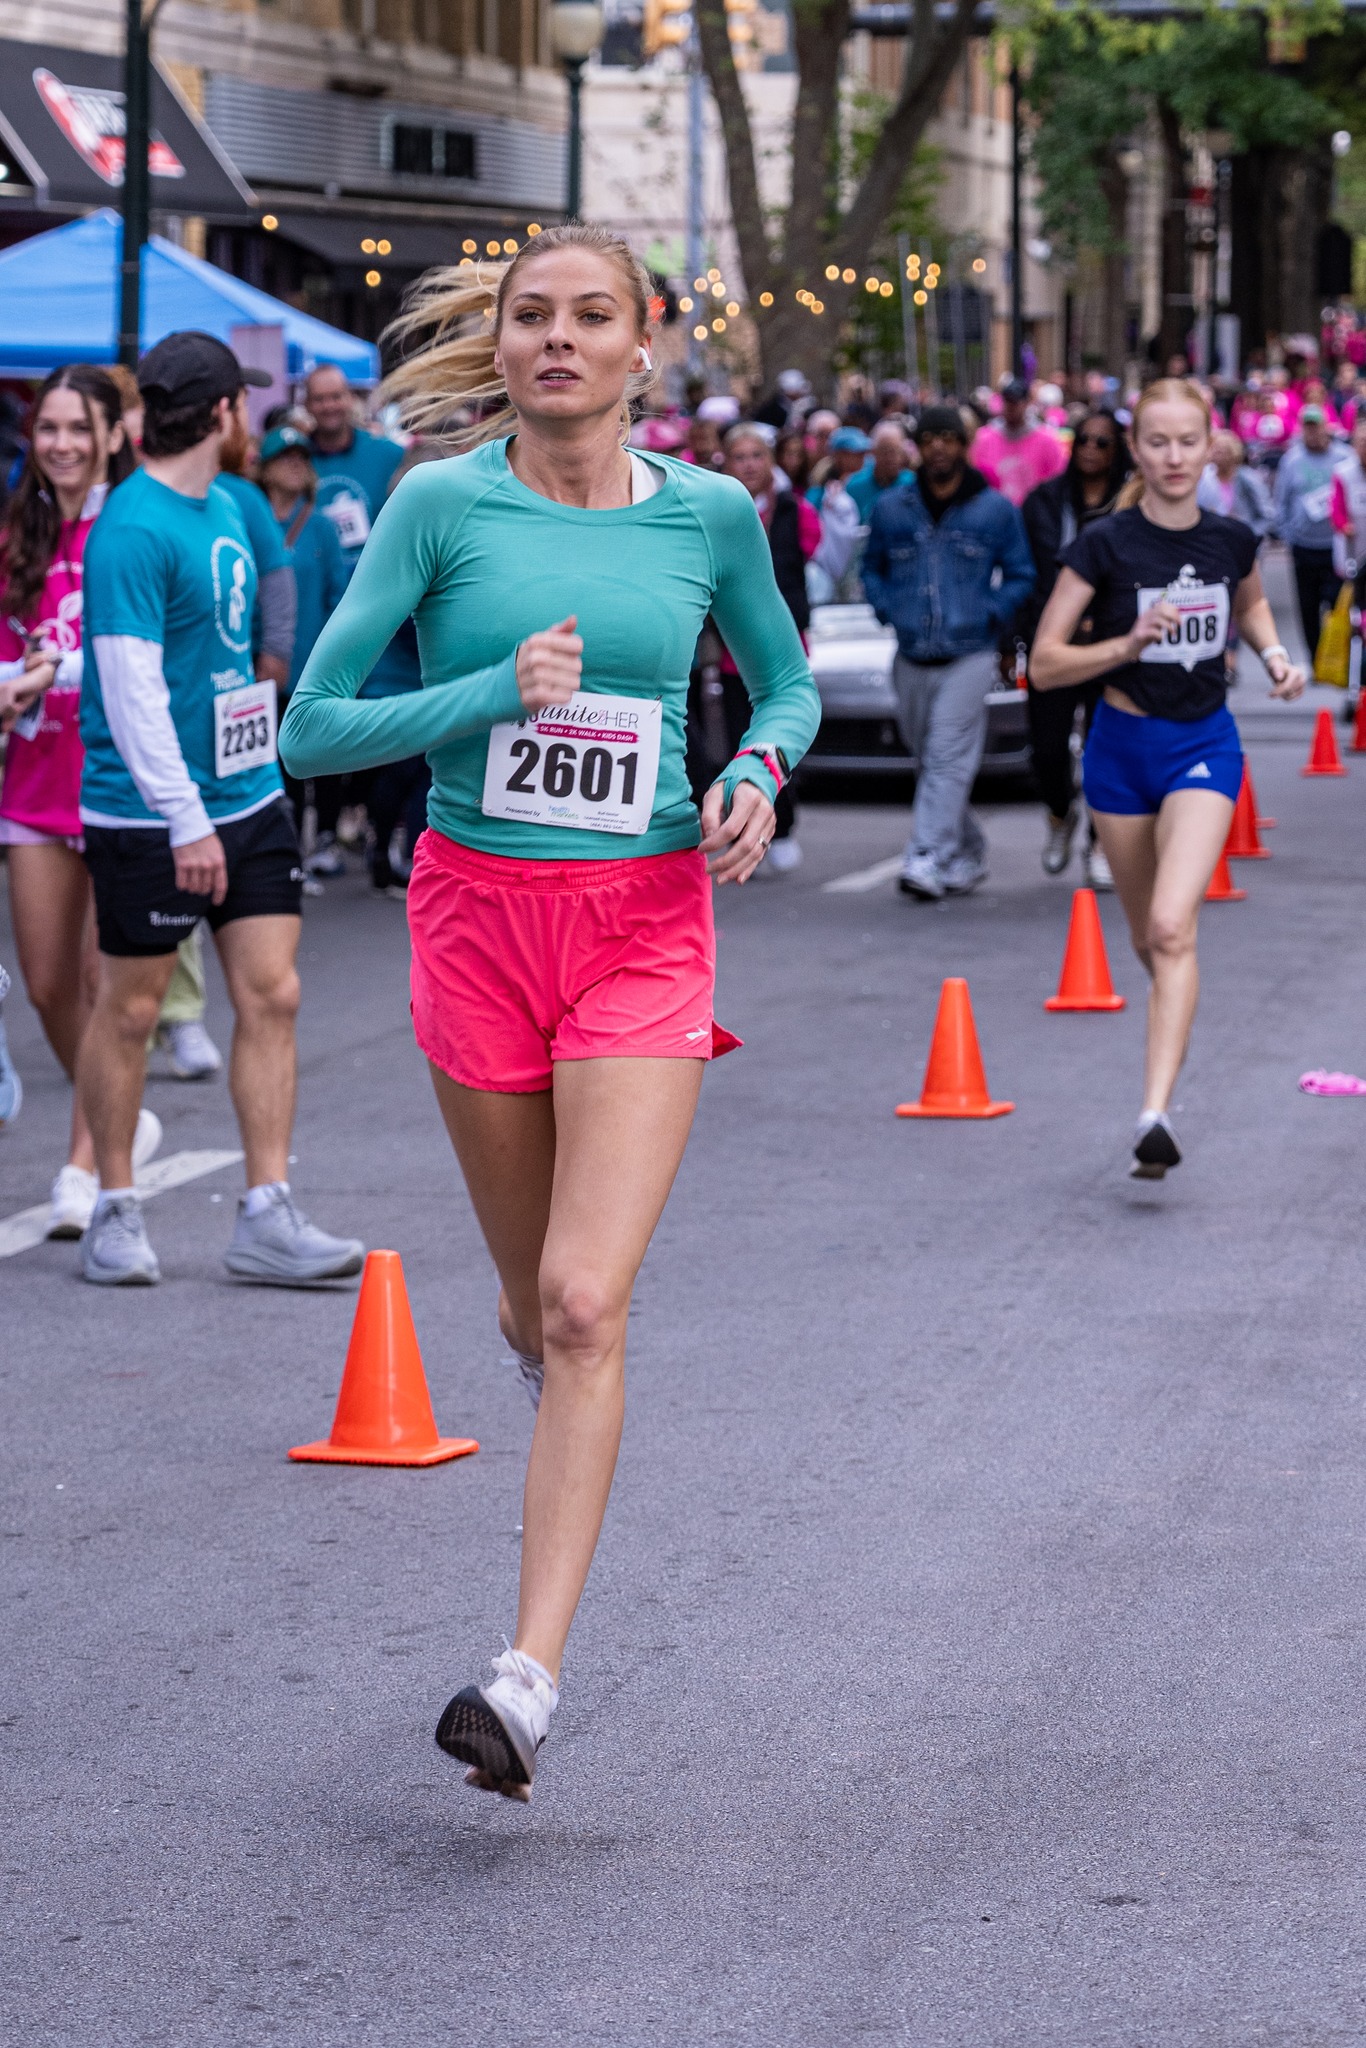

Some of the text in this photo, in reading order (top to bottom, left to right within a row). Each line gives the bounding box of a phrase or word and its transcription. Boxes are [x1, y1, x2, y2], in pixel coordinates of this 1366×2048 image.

[1157, 615, 1217, 645] 008
[222, 716, 268, 757] 2233
[549, 726, 564, 735] RUN
[578, 729, 597, 738] WALK
[601, 731, 616, 740] KIDS
[616, 733, 634, 742] DASH
[505, 738, 639, 805] 2601
[505, 806, 541, 818] Presented by
